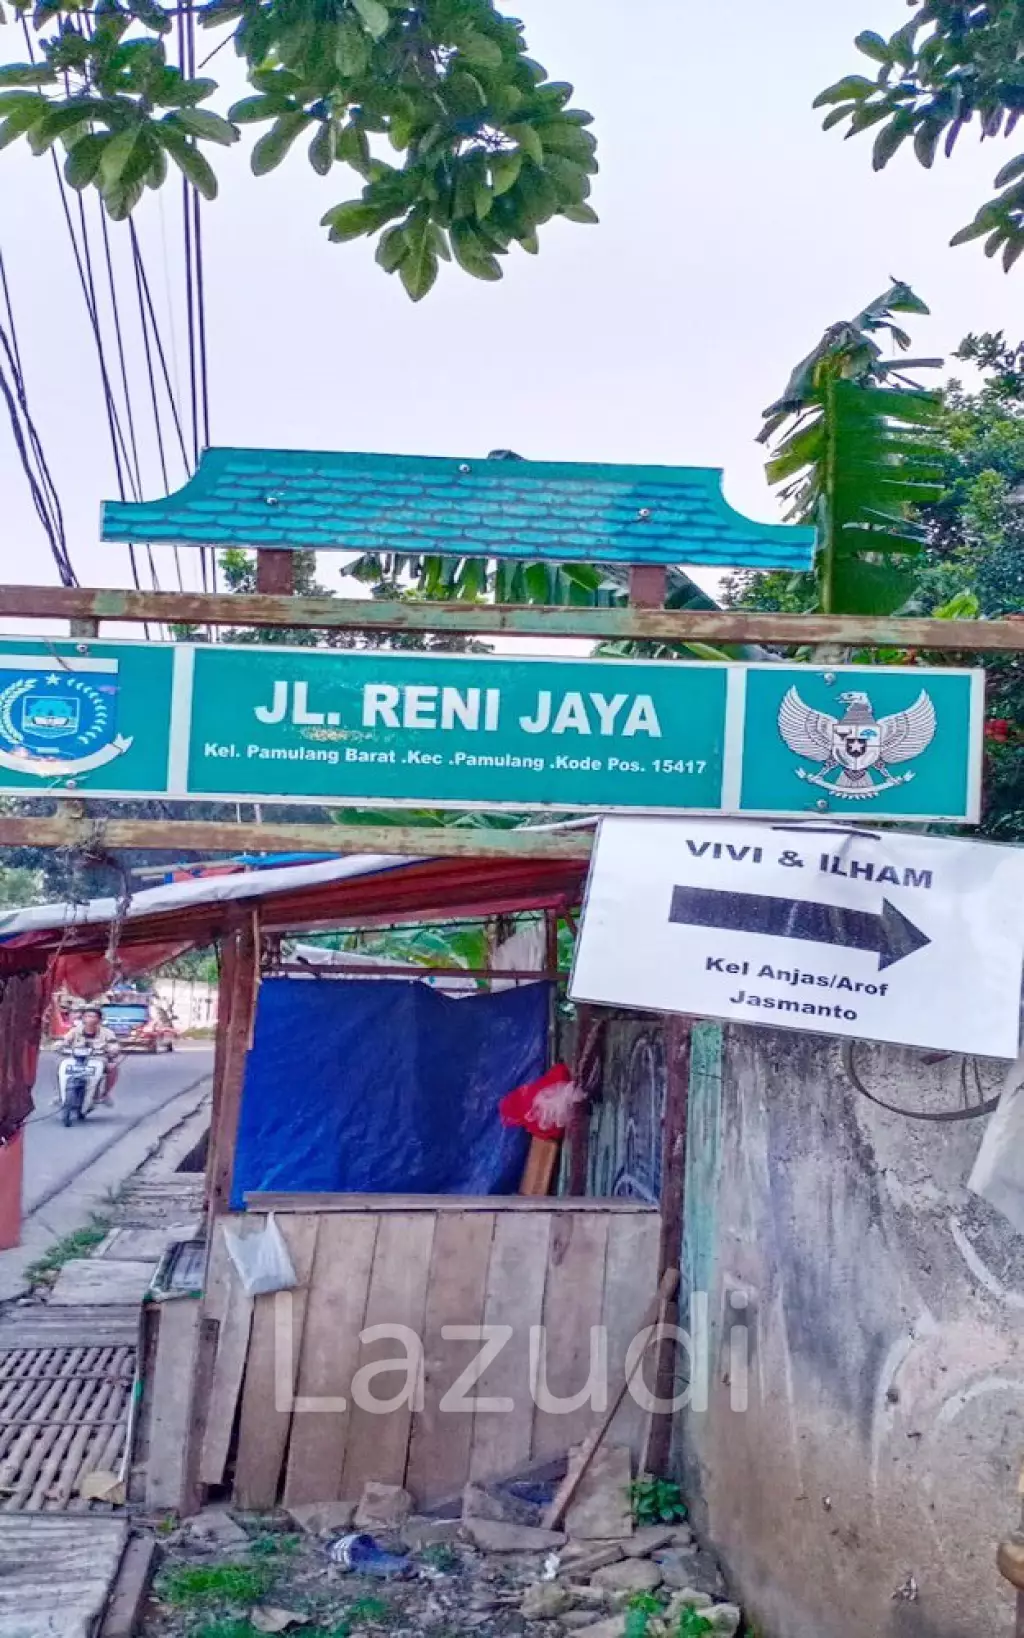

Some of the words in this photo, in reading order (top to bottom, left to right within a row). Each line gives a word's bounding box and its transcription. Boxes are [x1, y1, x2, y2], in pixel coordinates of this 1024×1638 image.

[254, 681, 341, 726] JL.
[362, 684, 500, 731] RENI
[519, 690, 662, 738] JAYA
[204, 743, 241, 758] Kel.
[247, 745, 339, 763] Pamulang
[345, 748, 396, 763] Barat
[607, 757, 646, 773] Pos.
[652, 759, 706, 774] 15417
[686, 839, 762, 864] VIVI
[778, 849, 804, 868] &
[819, 853, 933, 889] ILHAM
[705, 956, 749, 976] Kel
[757, 963, 888, 996] Anjas/Arof
[730, 990, 858, 1021] Jasmanto
